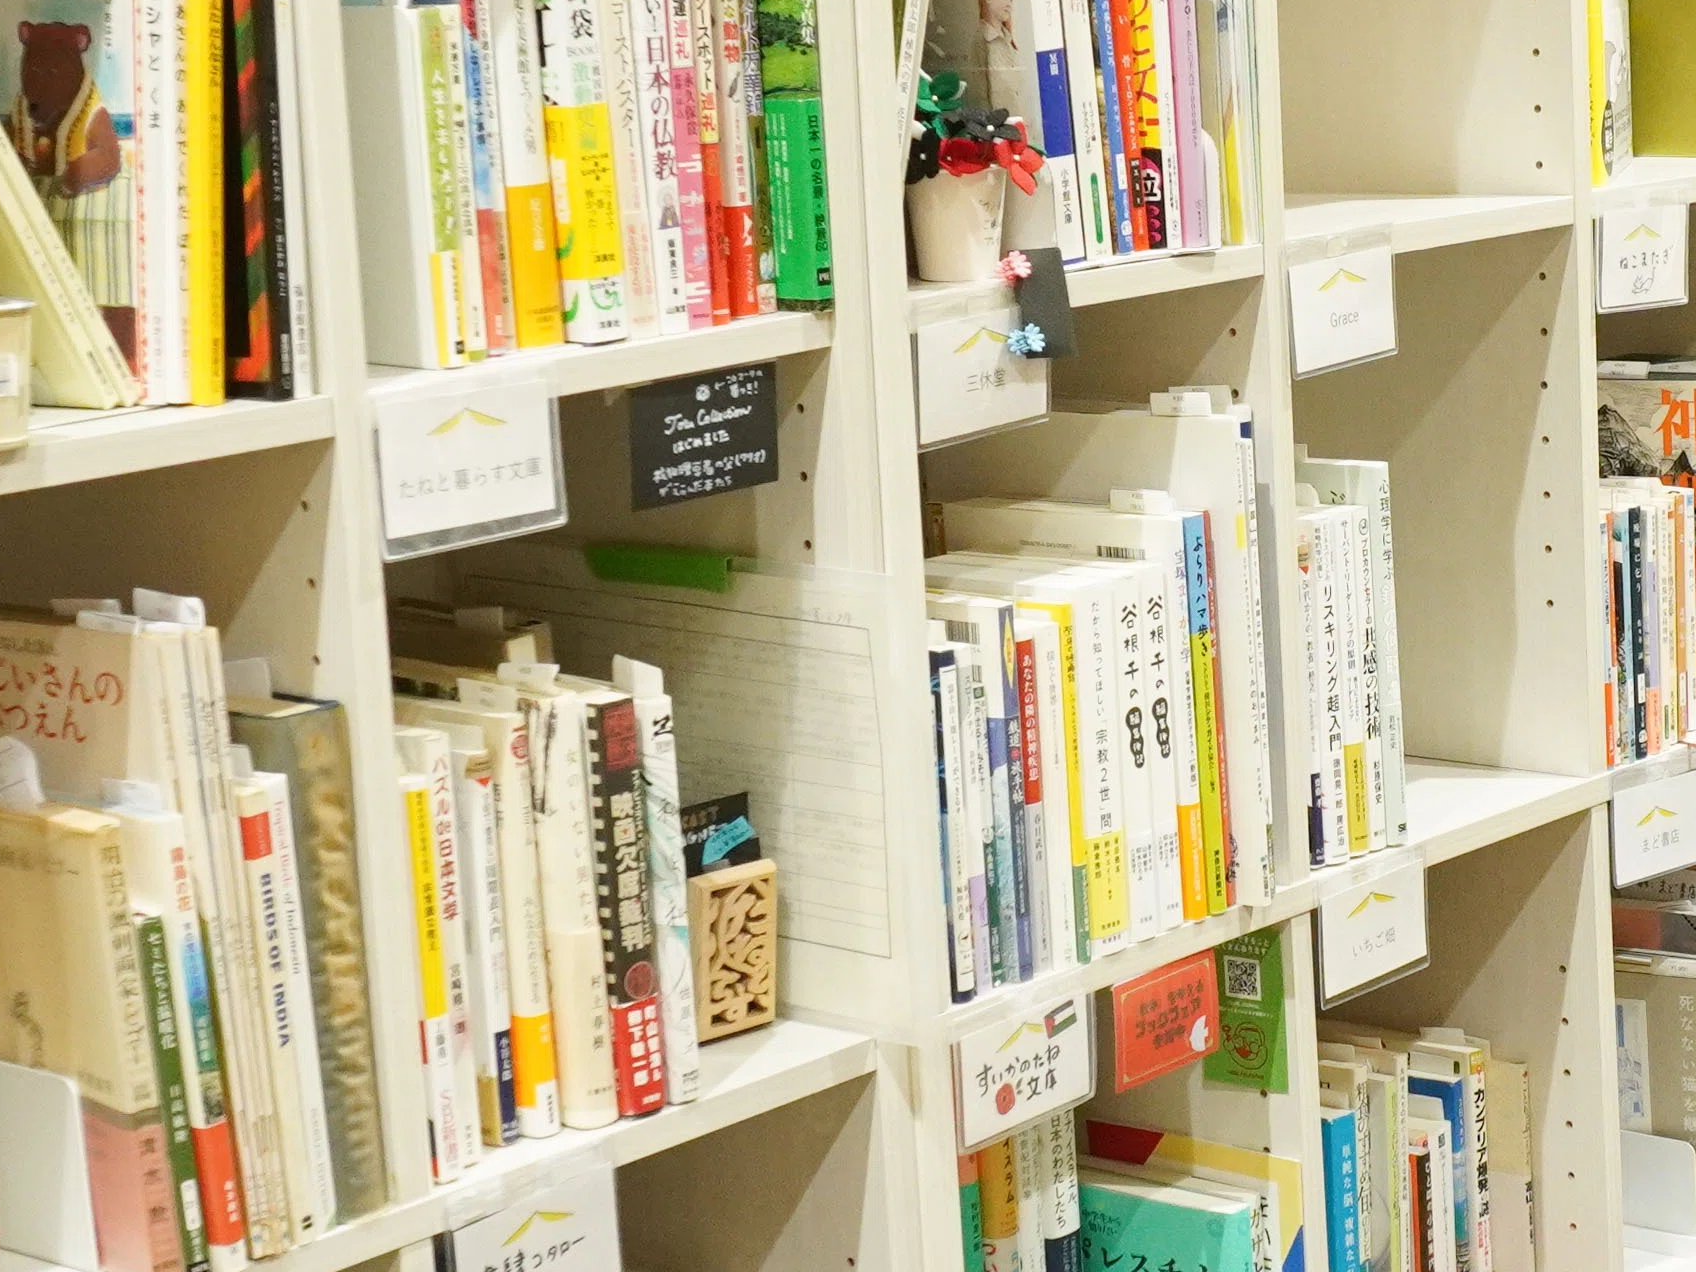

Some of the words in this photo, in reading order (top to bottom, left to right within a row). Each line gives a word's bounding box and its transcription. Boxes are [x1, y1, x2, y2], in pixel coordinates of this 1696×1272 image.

[644, 34, 678, 180] 日本の仏教
[1328, 308, 1361, 329] Grace
[397, 456, 544, 500] たねと暮らす文庫
[1321, 583, 1343, 753] リスキリング超入門
[1361, 625, 1383, 742] 共感の技術
[1641, 831, 1681, 854] まど書店
[259, 872, 278, 940] BIRDS
[269, 942, 283, 975] OF
[1351, 931, 1397, 961] いちご畑
[273, 983, 291, 1049] INDIA
[973, 1043, 1062, 1099] すいかのたね
[1024, 1067, 1059, 1099] 文庫
[1049, 1114, 1068, 1230] 日本のわたしたち
